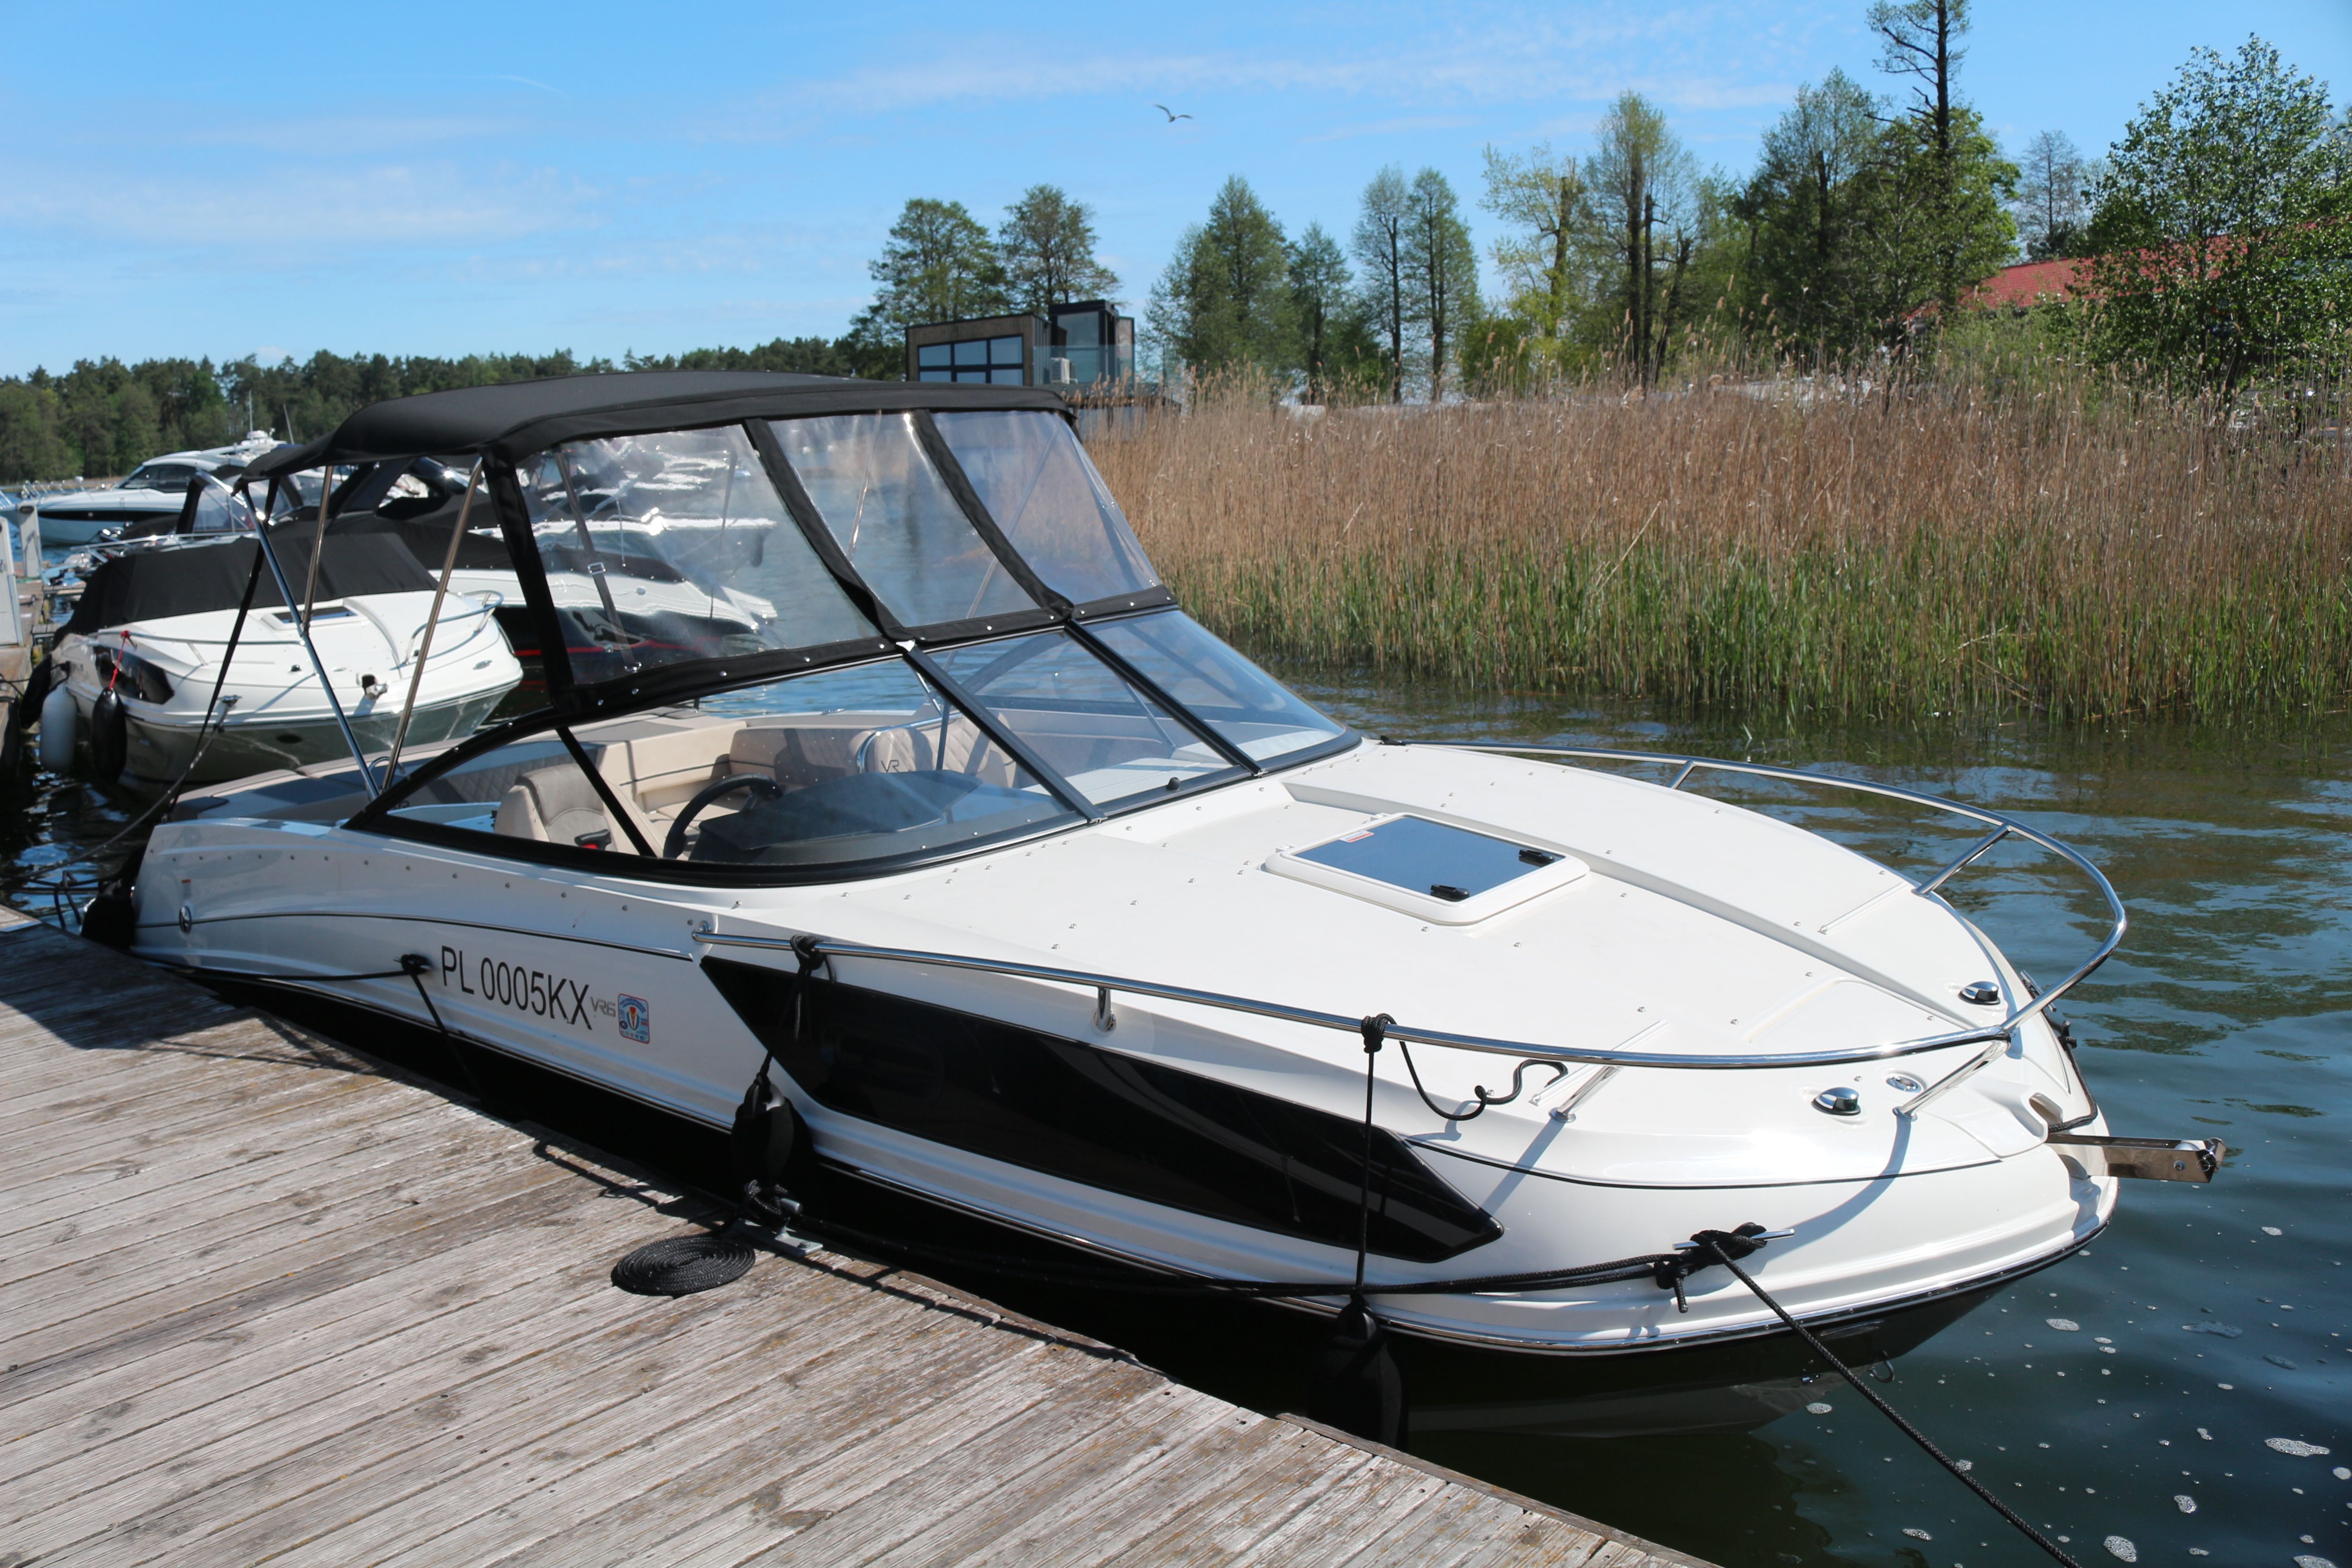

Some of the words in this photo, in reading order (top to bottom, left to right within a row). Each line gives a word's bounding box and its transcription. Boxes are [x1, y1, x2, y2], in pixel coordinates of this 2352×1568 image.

[881, 760, 900, 773] VR
[441, 945, 474, 995] PL
[481, 957, 592, 1030] 0005KX
[590, 996, 616, 1017] VR6
